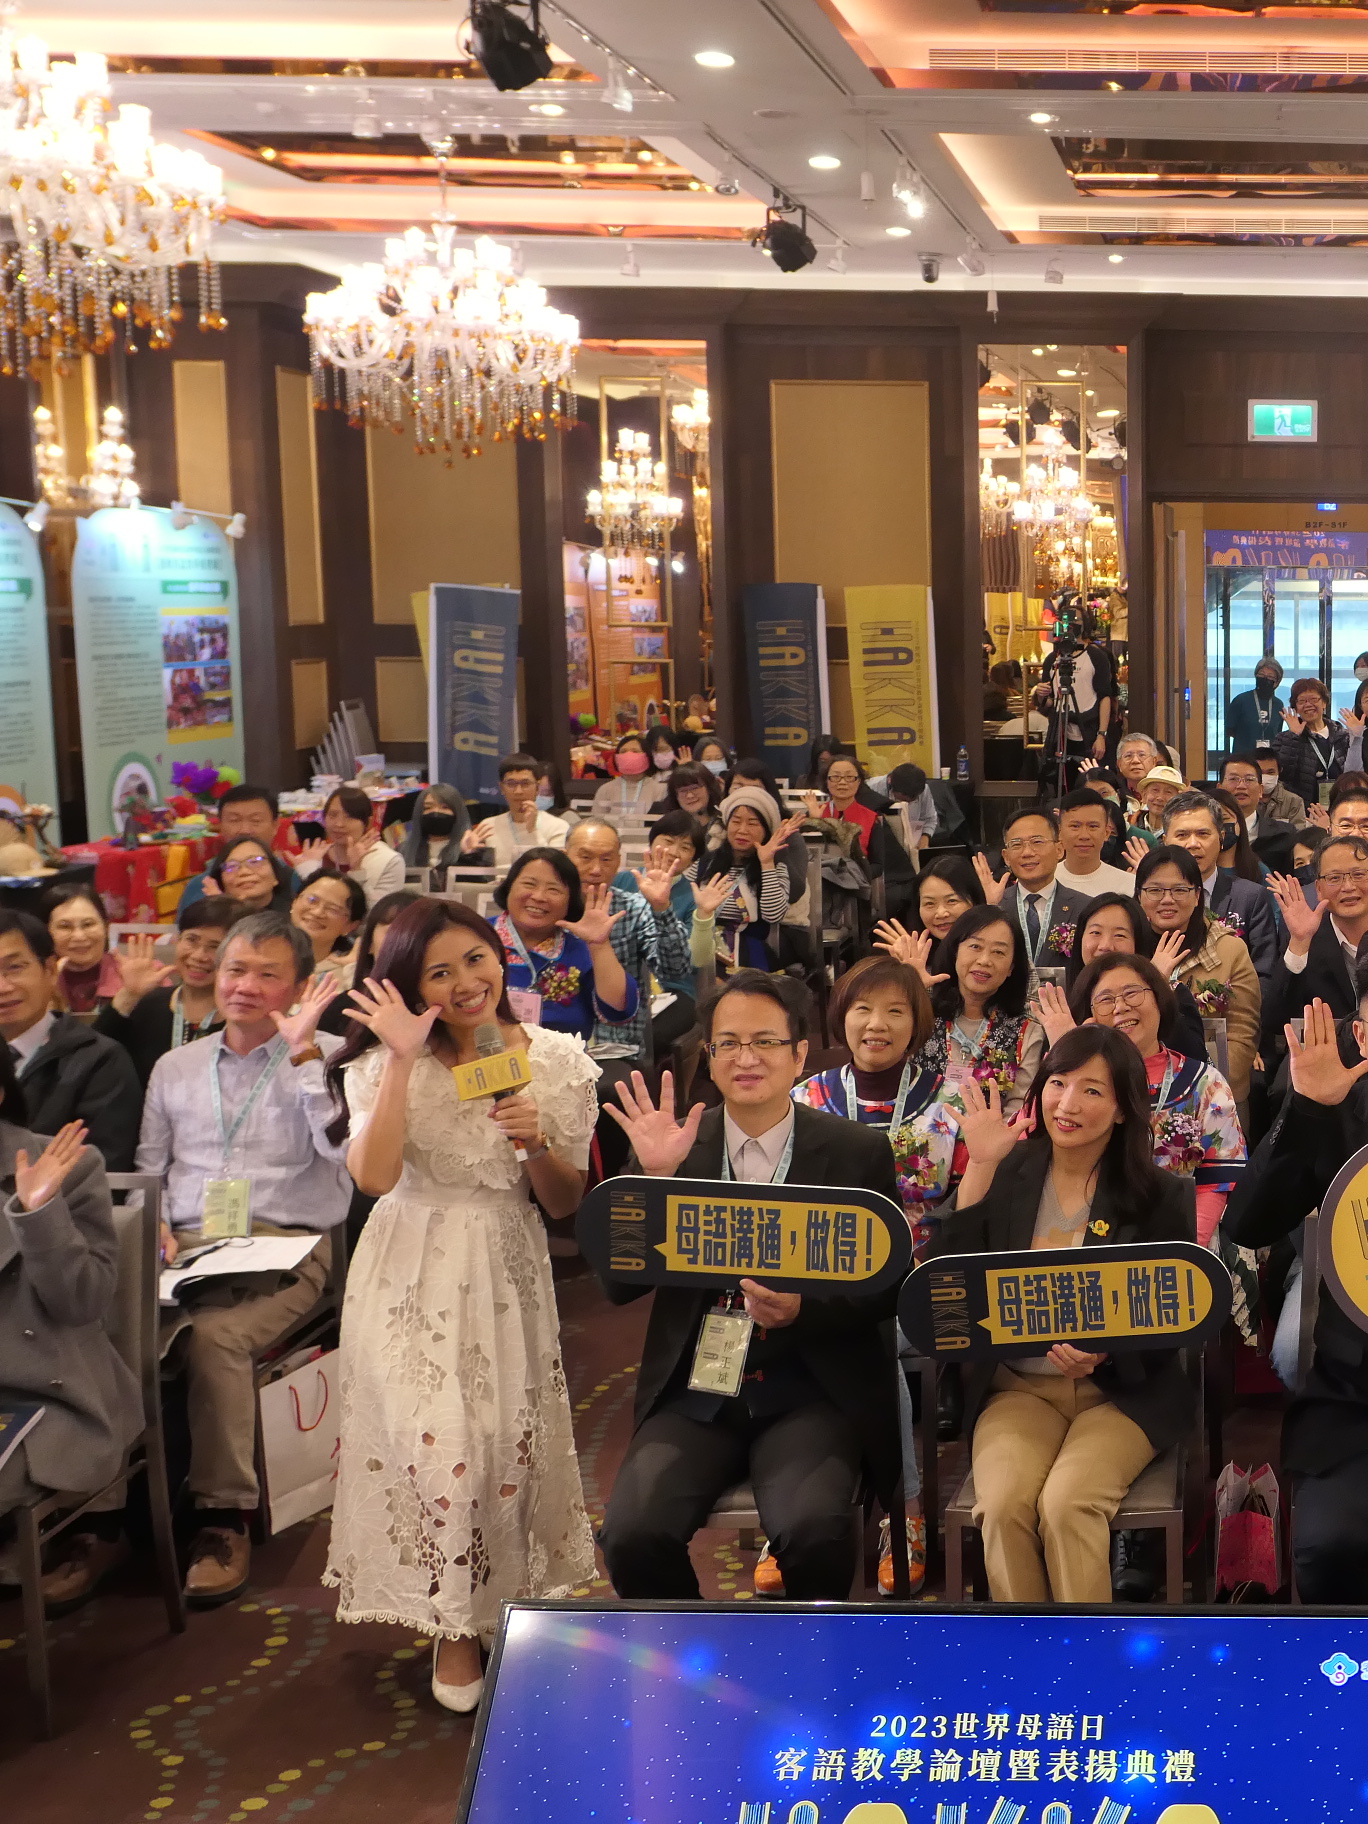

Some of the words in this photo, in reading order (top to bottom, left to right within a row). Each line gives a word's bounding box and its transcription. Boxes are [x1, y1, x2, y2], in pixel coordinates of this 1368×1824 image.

[756, 619, 809, 747] HAKKA
[859, 620, 917, 747] HAKKA
[610, 1191, 647, 1271] HAKKA
[928, 1270, 971, 1351] HAKKA
[773, 1748, 1198, 1784] 客語教學論壇暨表揚典禮
[870, 1712, 1105, 1742] 2023世界母語日
